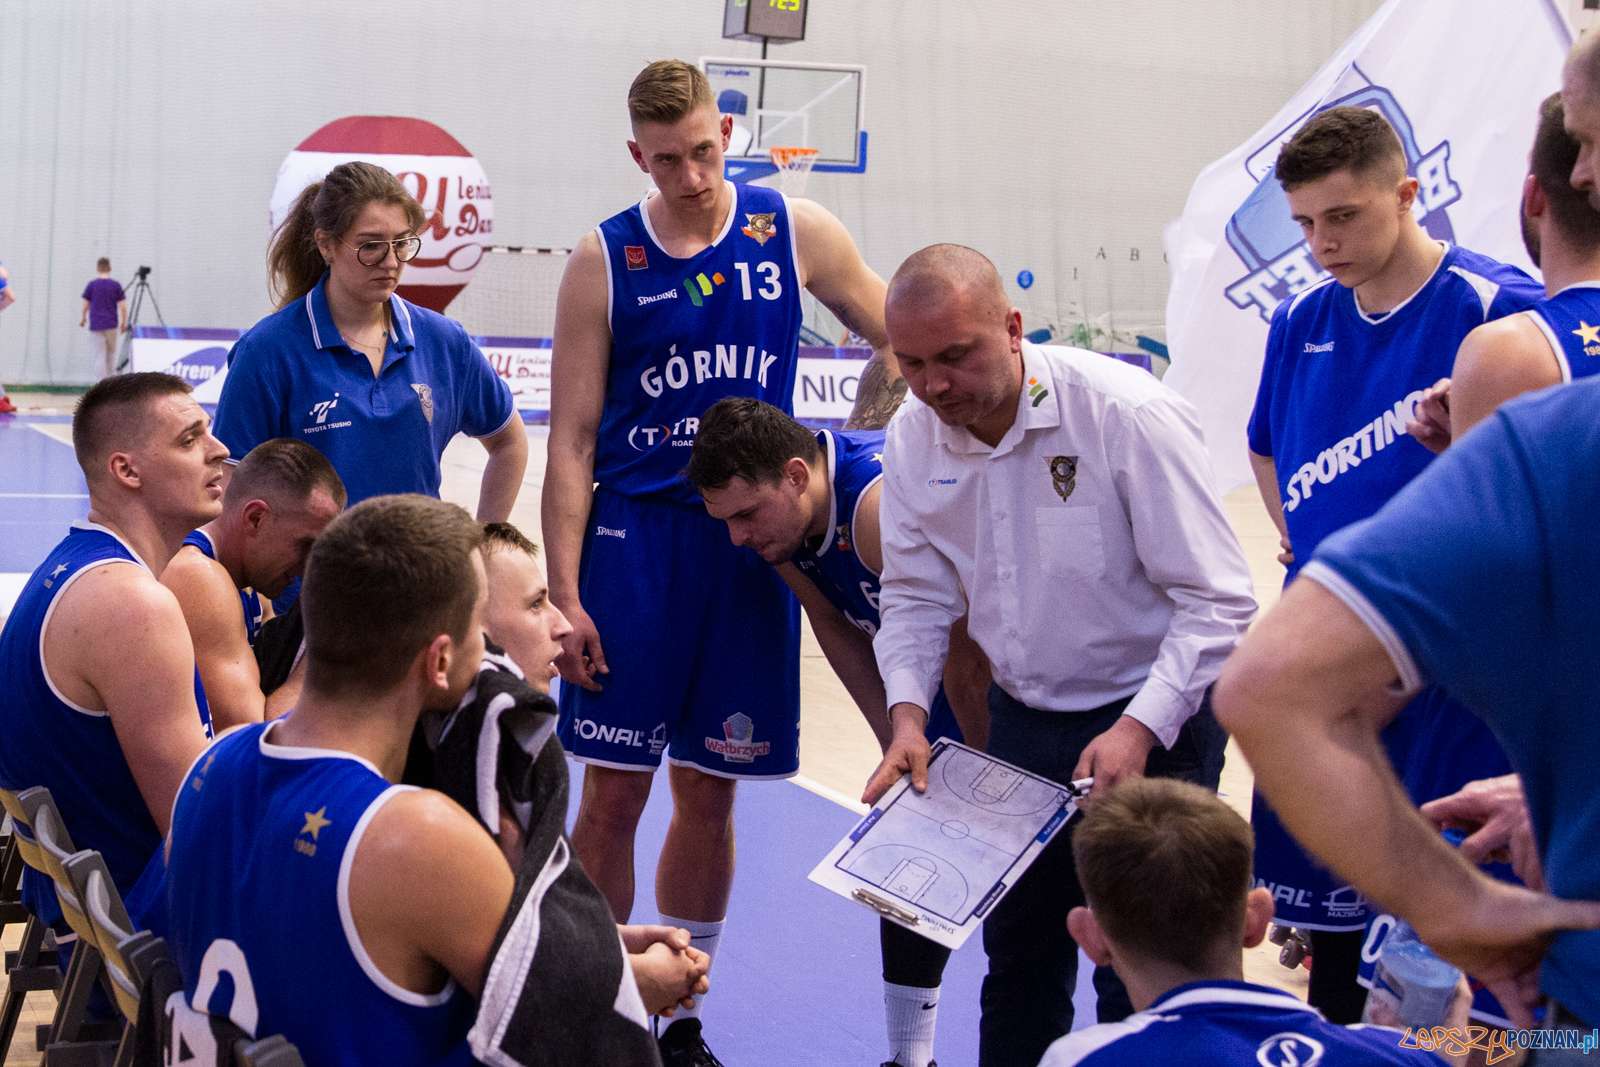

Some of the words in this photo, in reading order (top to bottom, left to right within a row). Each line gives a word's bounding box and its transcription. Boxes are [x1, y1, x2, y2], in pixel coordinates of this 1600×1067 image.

[734, 261, 782, 301] 13
[637, 288, 678, 306] SPALDING
[1303, 341, 1335, 353] SPALDING
[640, 343, 778, 398] GÓRNIK
[303, 425, 327, 434] TOYOTA
[327, 420, 352, 430] TSUSHO
[596, 525, 626, 539] SPALDING
